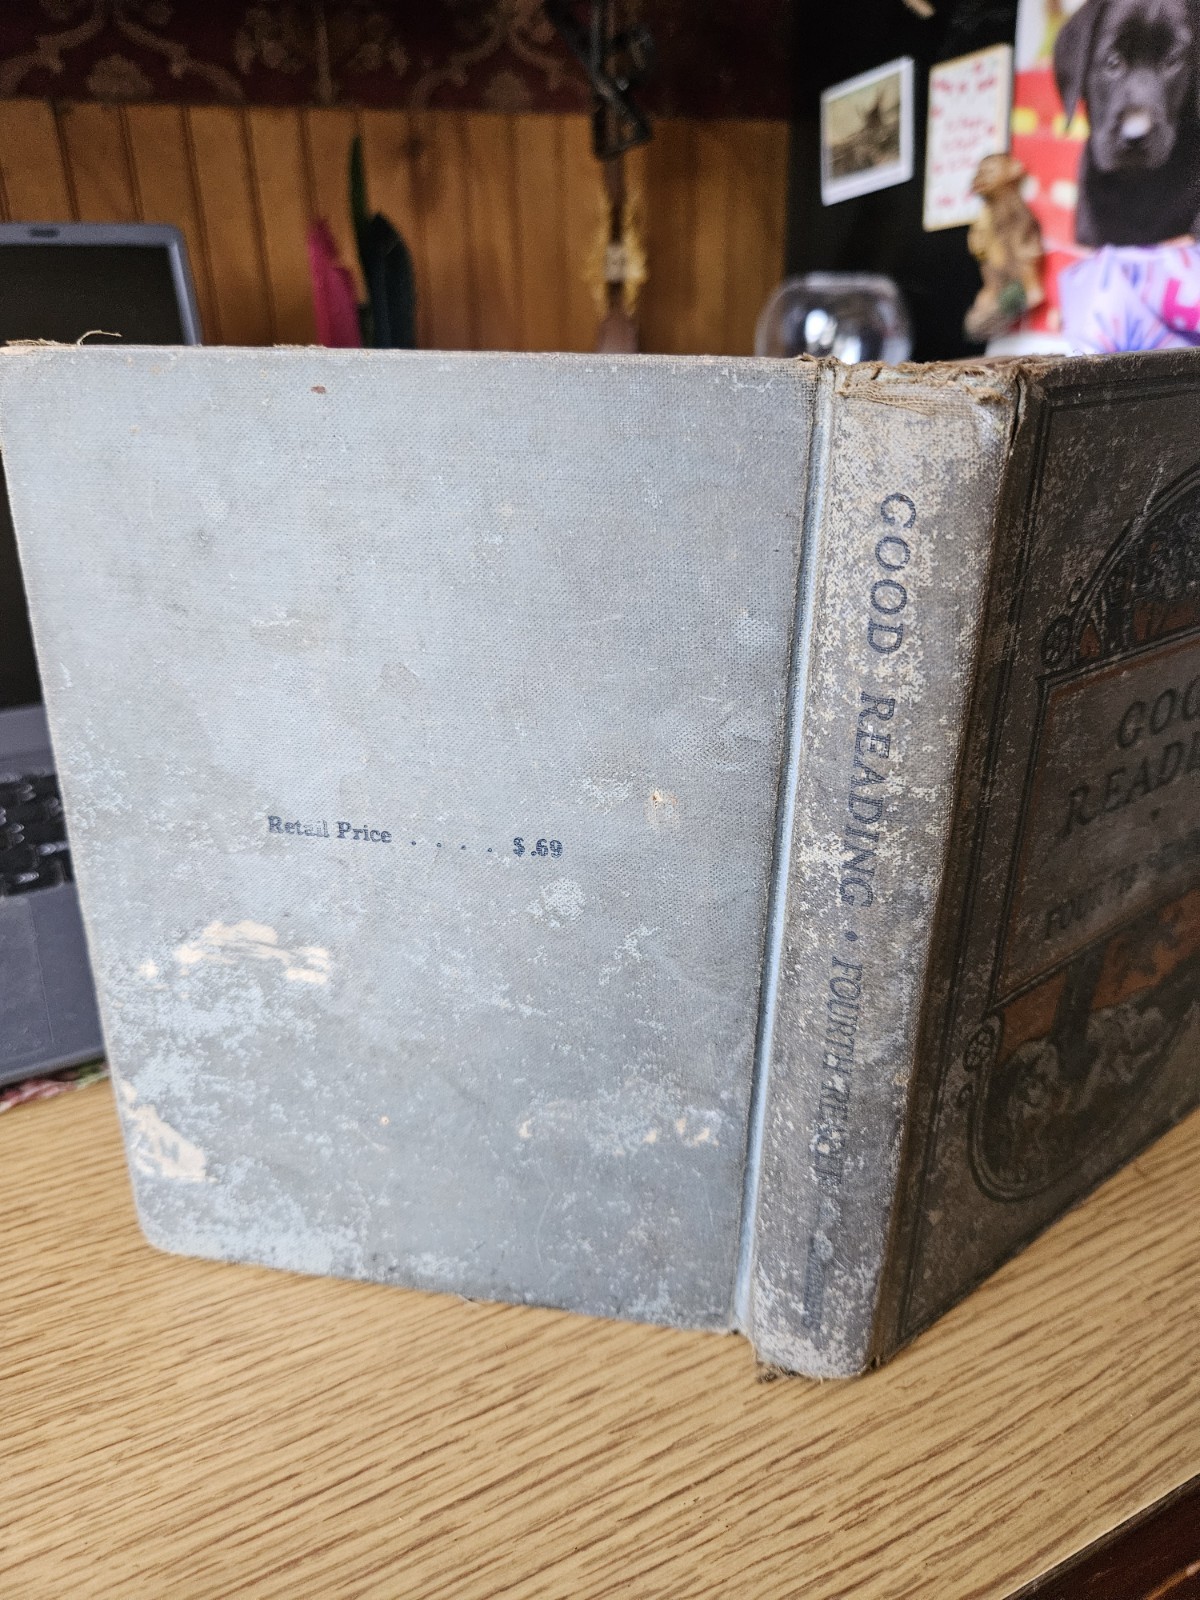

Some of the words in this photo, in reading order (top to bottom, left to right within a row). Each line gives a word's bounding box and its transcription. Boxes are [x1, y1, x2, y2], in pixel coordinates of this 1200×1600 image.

[866, 491, 917, 655] GOOD
[267, 815, 330, 838] Retail
[336, 821, 393, 843] Price
[839, 691, 896, 908] READING
[821, 956, 863, 1075] FOURTH
